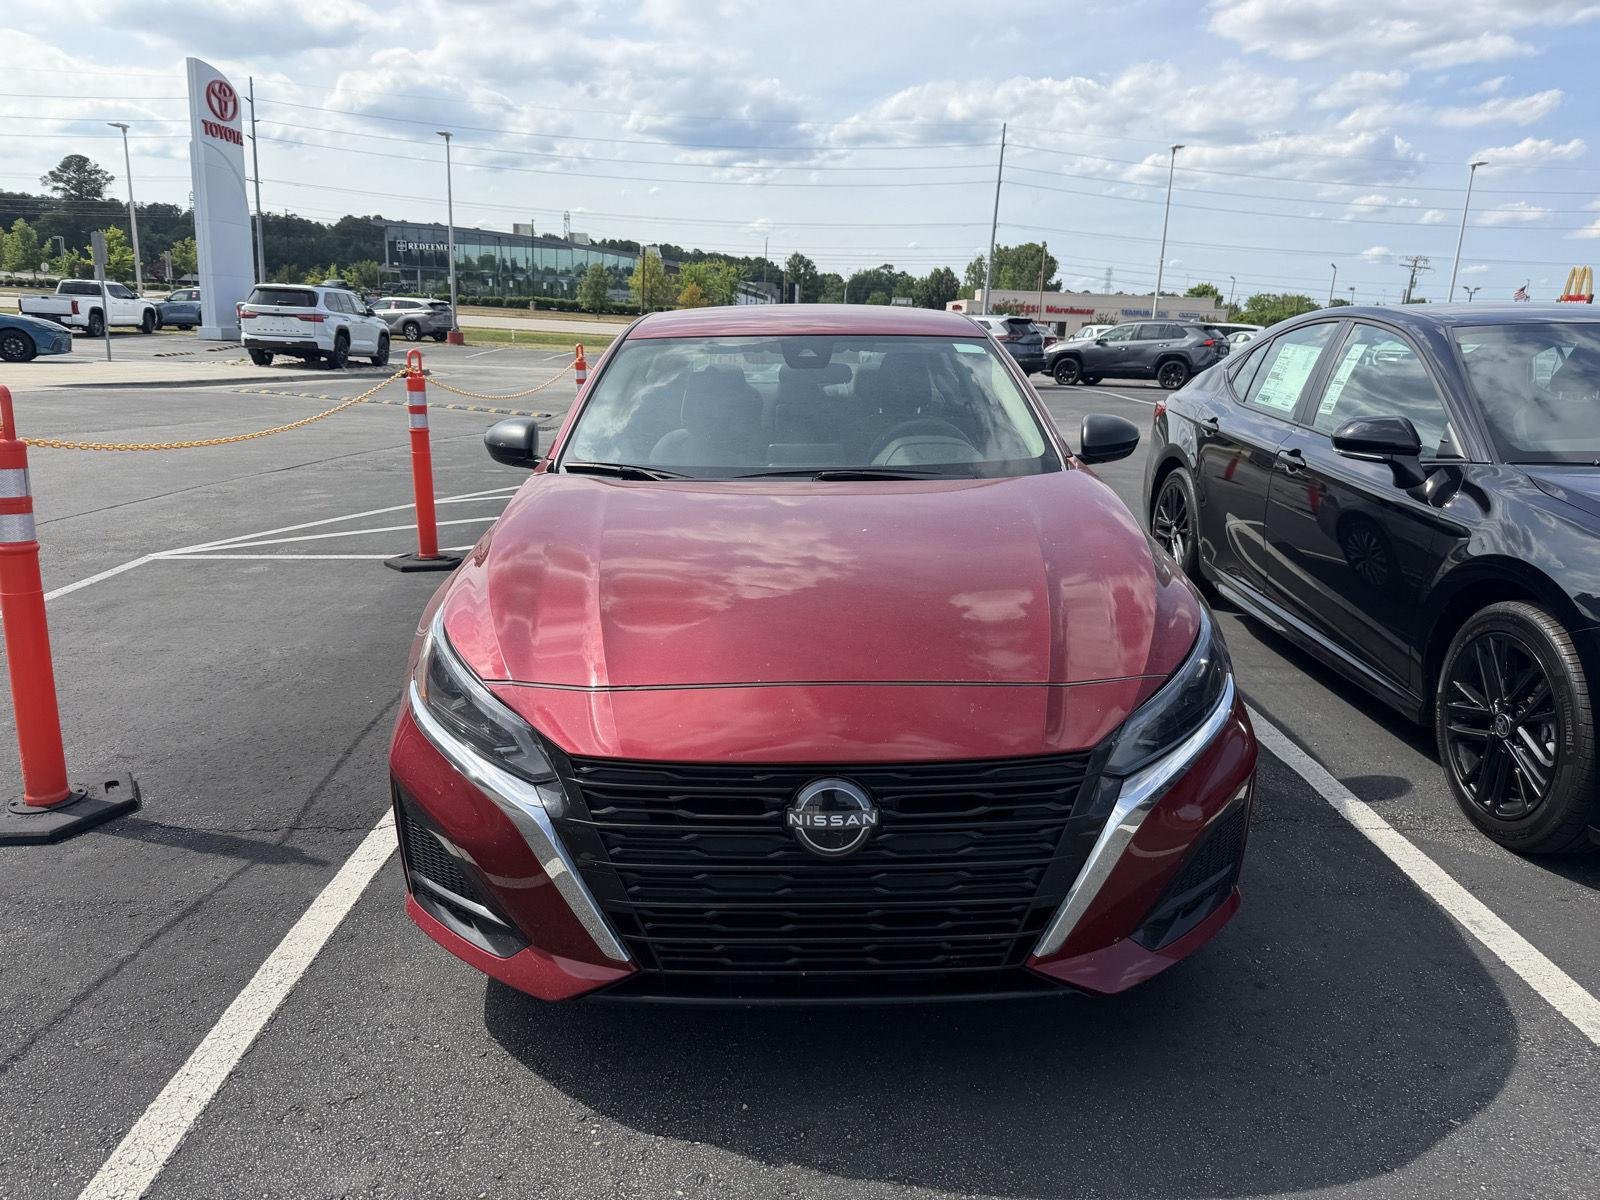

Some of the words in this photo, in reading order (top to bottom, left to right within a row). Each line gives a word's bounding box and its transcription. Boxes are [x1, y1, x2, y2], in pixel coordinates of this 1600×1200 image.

[201, 119, 244, 146] TOYOTA
[408, 242, 456, 251] REDEEME
[789, 813, 875, 827] NISSAN
